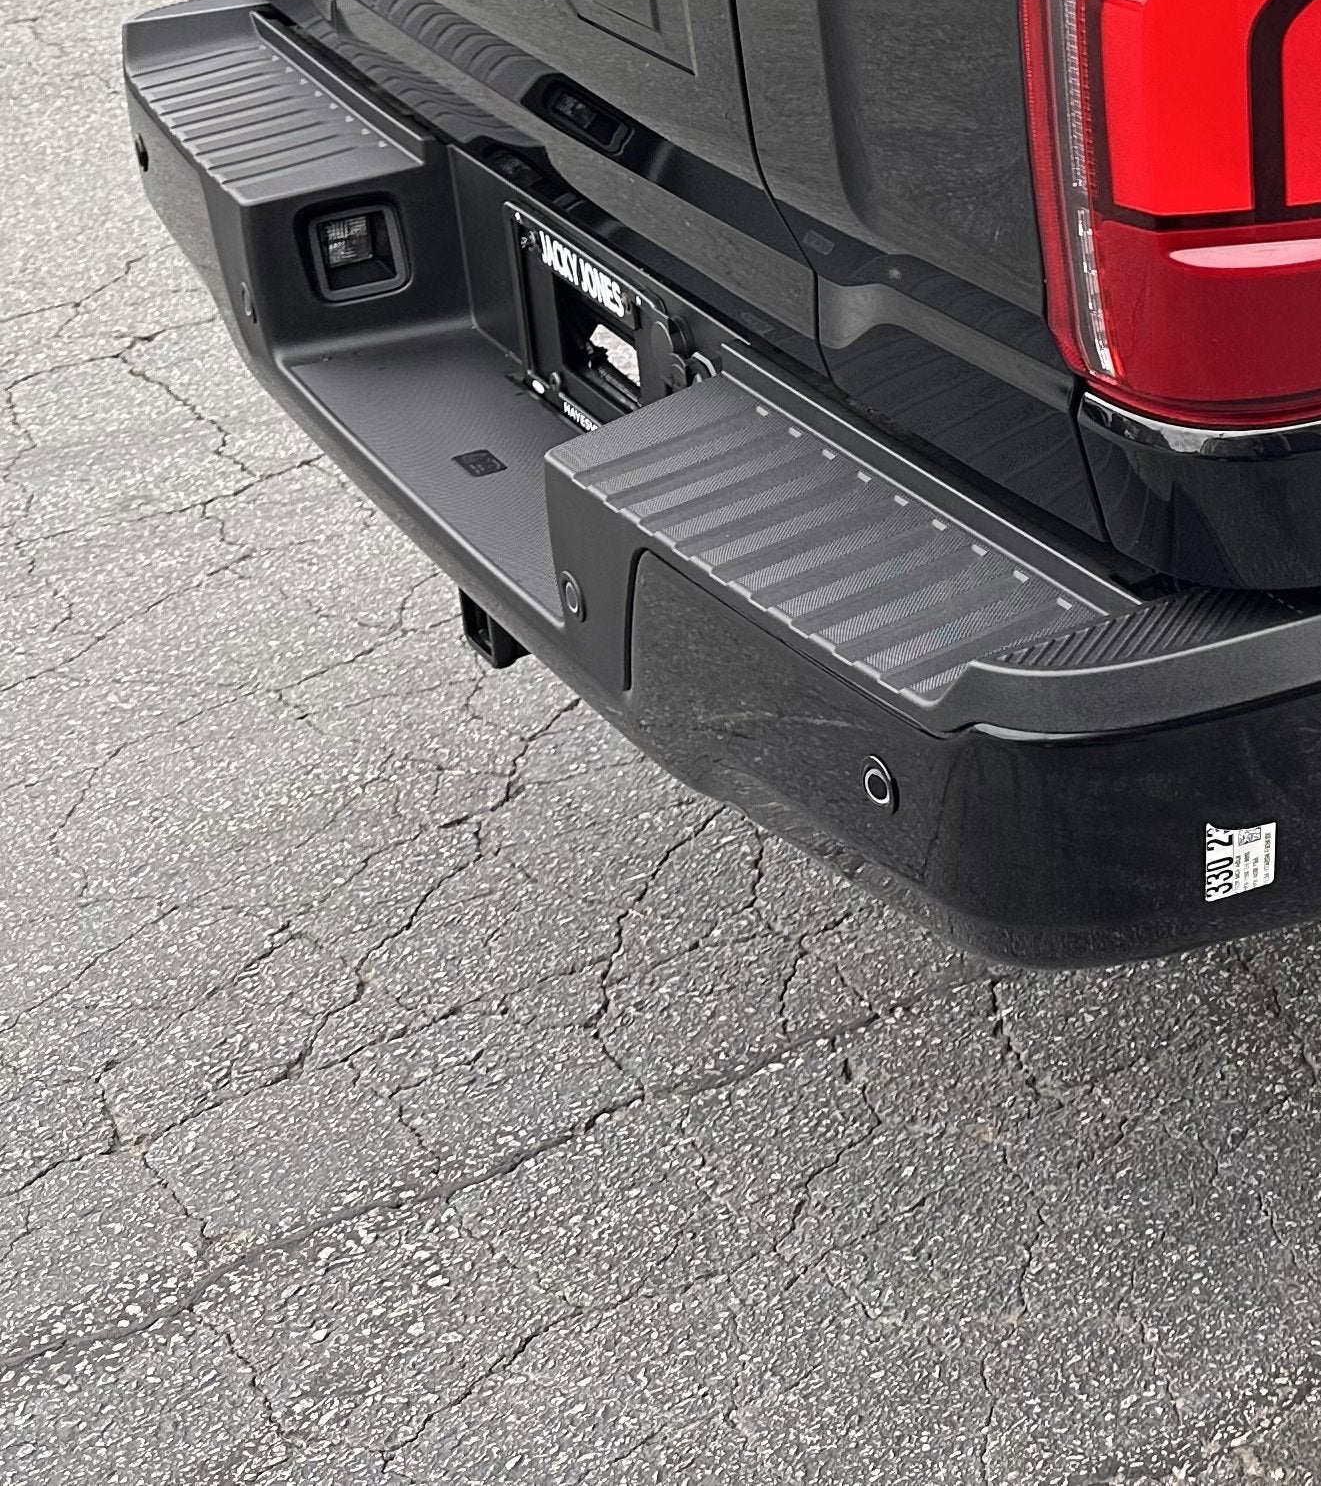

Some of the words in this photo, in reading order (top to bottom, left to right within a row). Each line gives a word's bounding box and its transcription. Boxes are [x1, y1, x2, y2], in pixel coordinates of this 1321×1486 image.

[538, 229, 580, 287] JACKY
[578, 257, 626, 319] JONES
[1206, 856, 1234, 898] 330
